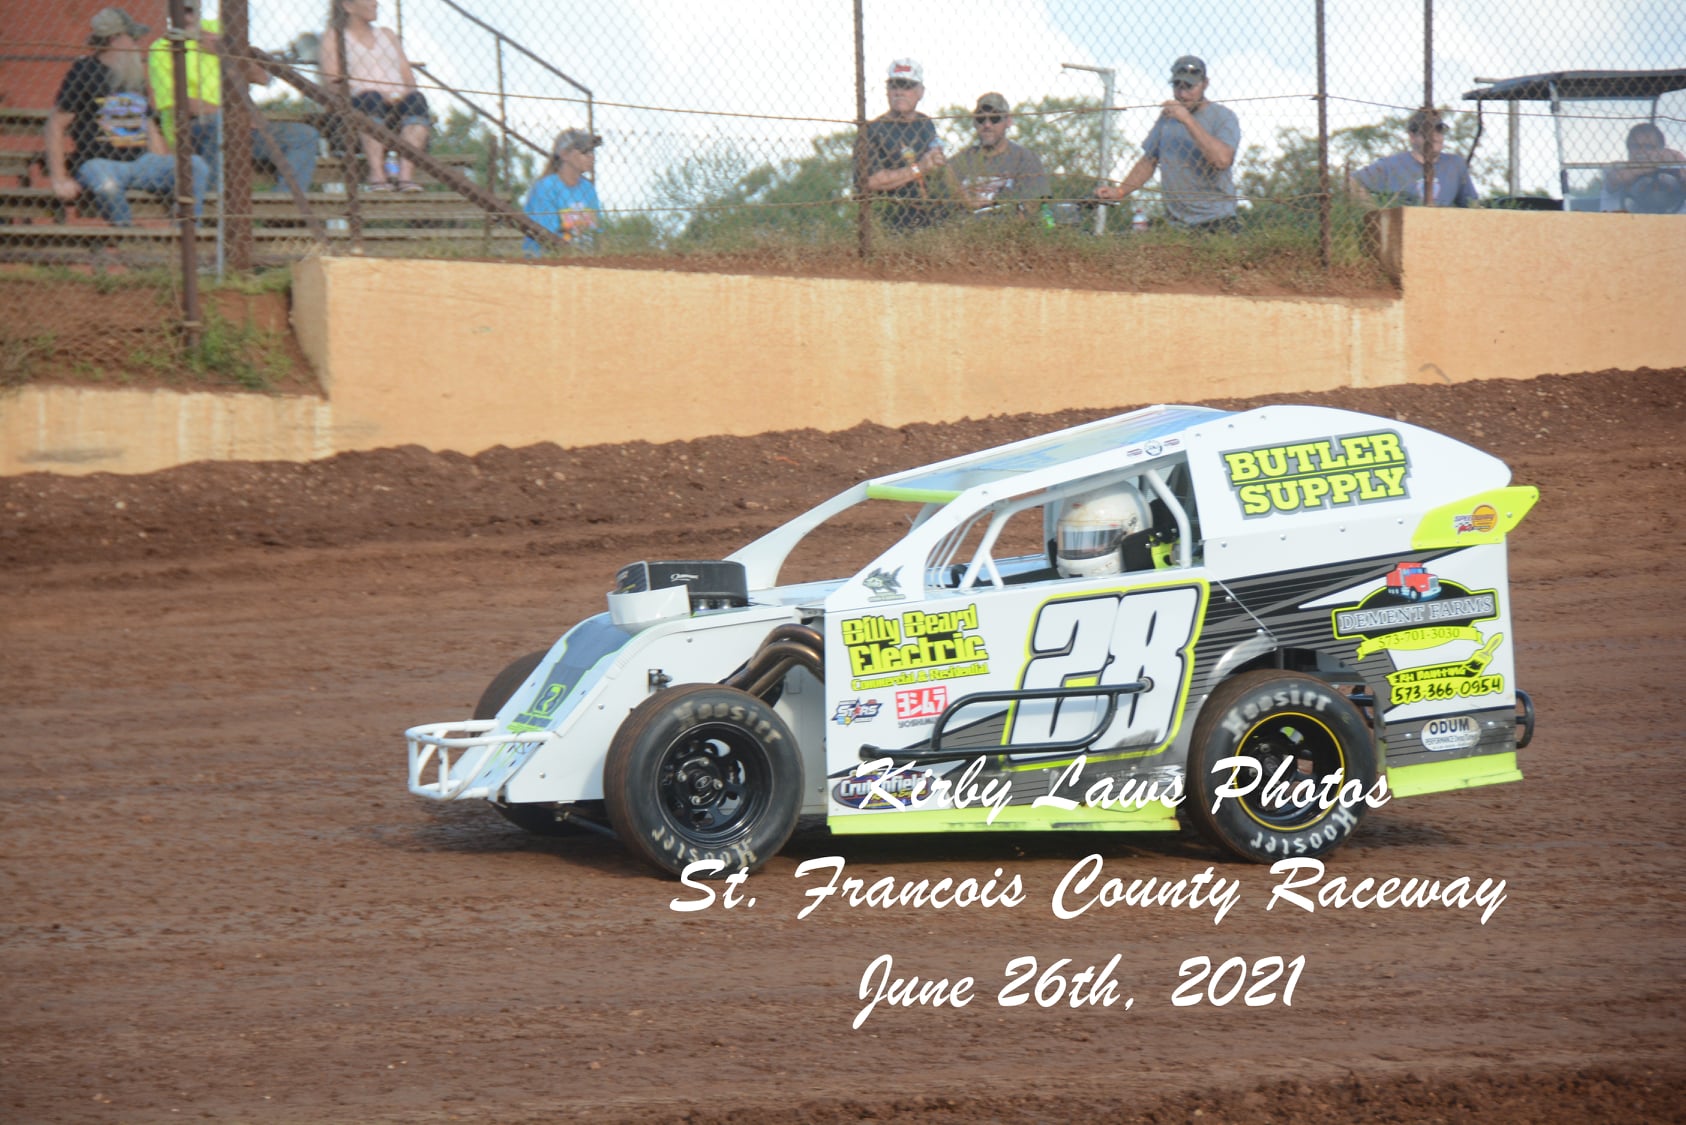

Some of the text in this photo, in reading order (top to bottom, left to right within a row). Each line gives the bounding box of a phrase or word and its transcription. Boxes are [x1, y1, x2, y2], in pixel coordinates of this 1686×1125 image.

[1223, 430, 1407, 483] BUTLER
[1237, 465, 1407, 516] SUPPLY
[841, 603, 979, 646] Billy Beard
[1339, 594, 1494, 631] DEMENT FARMS
[848, 632, 989, 677] Electric
[1377, 627, 1461, 649] 573-701-3030
[1005, 582, 1206, 768] 28
[1430, 718, 1470, 735] ODUM
